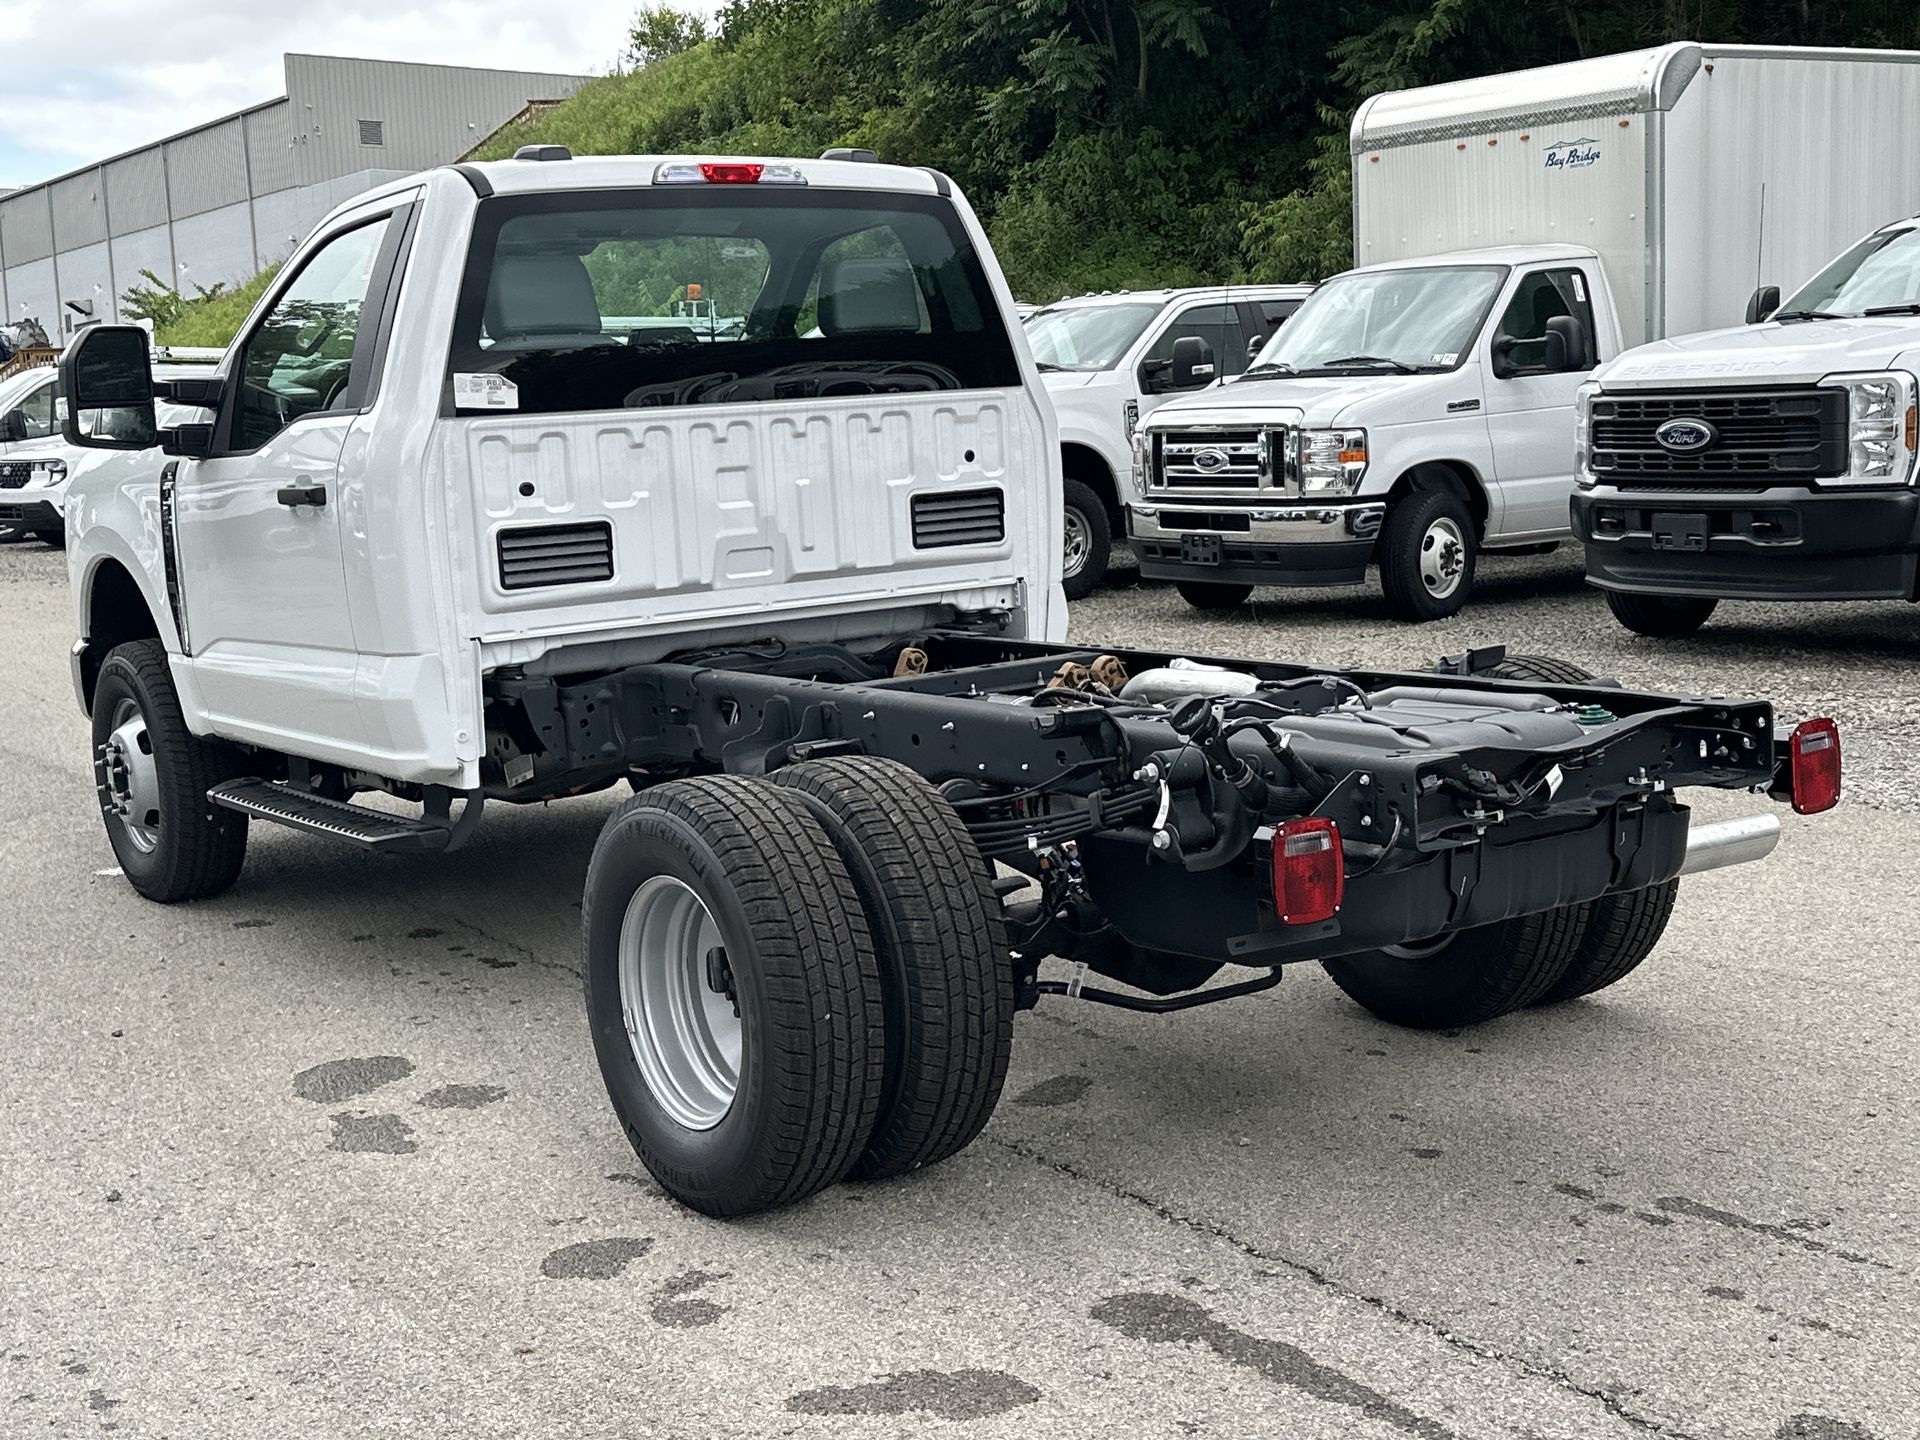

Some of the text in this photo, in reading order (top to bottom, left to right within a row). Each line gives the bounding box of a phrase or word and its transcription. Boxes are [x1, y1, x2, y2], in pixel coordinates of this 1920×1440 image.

[1545, 146, 1601, 170] Bay Bridge
[1620, 360, 1790, 376] SUPER DUTY
[1667, 428, 1697, 444] Ford
